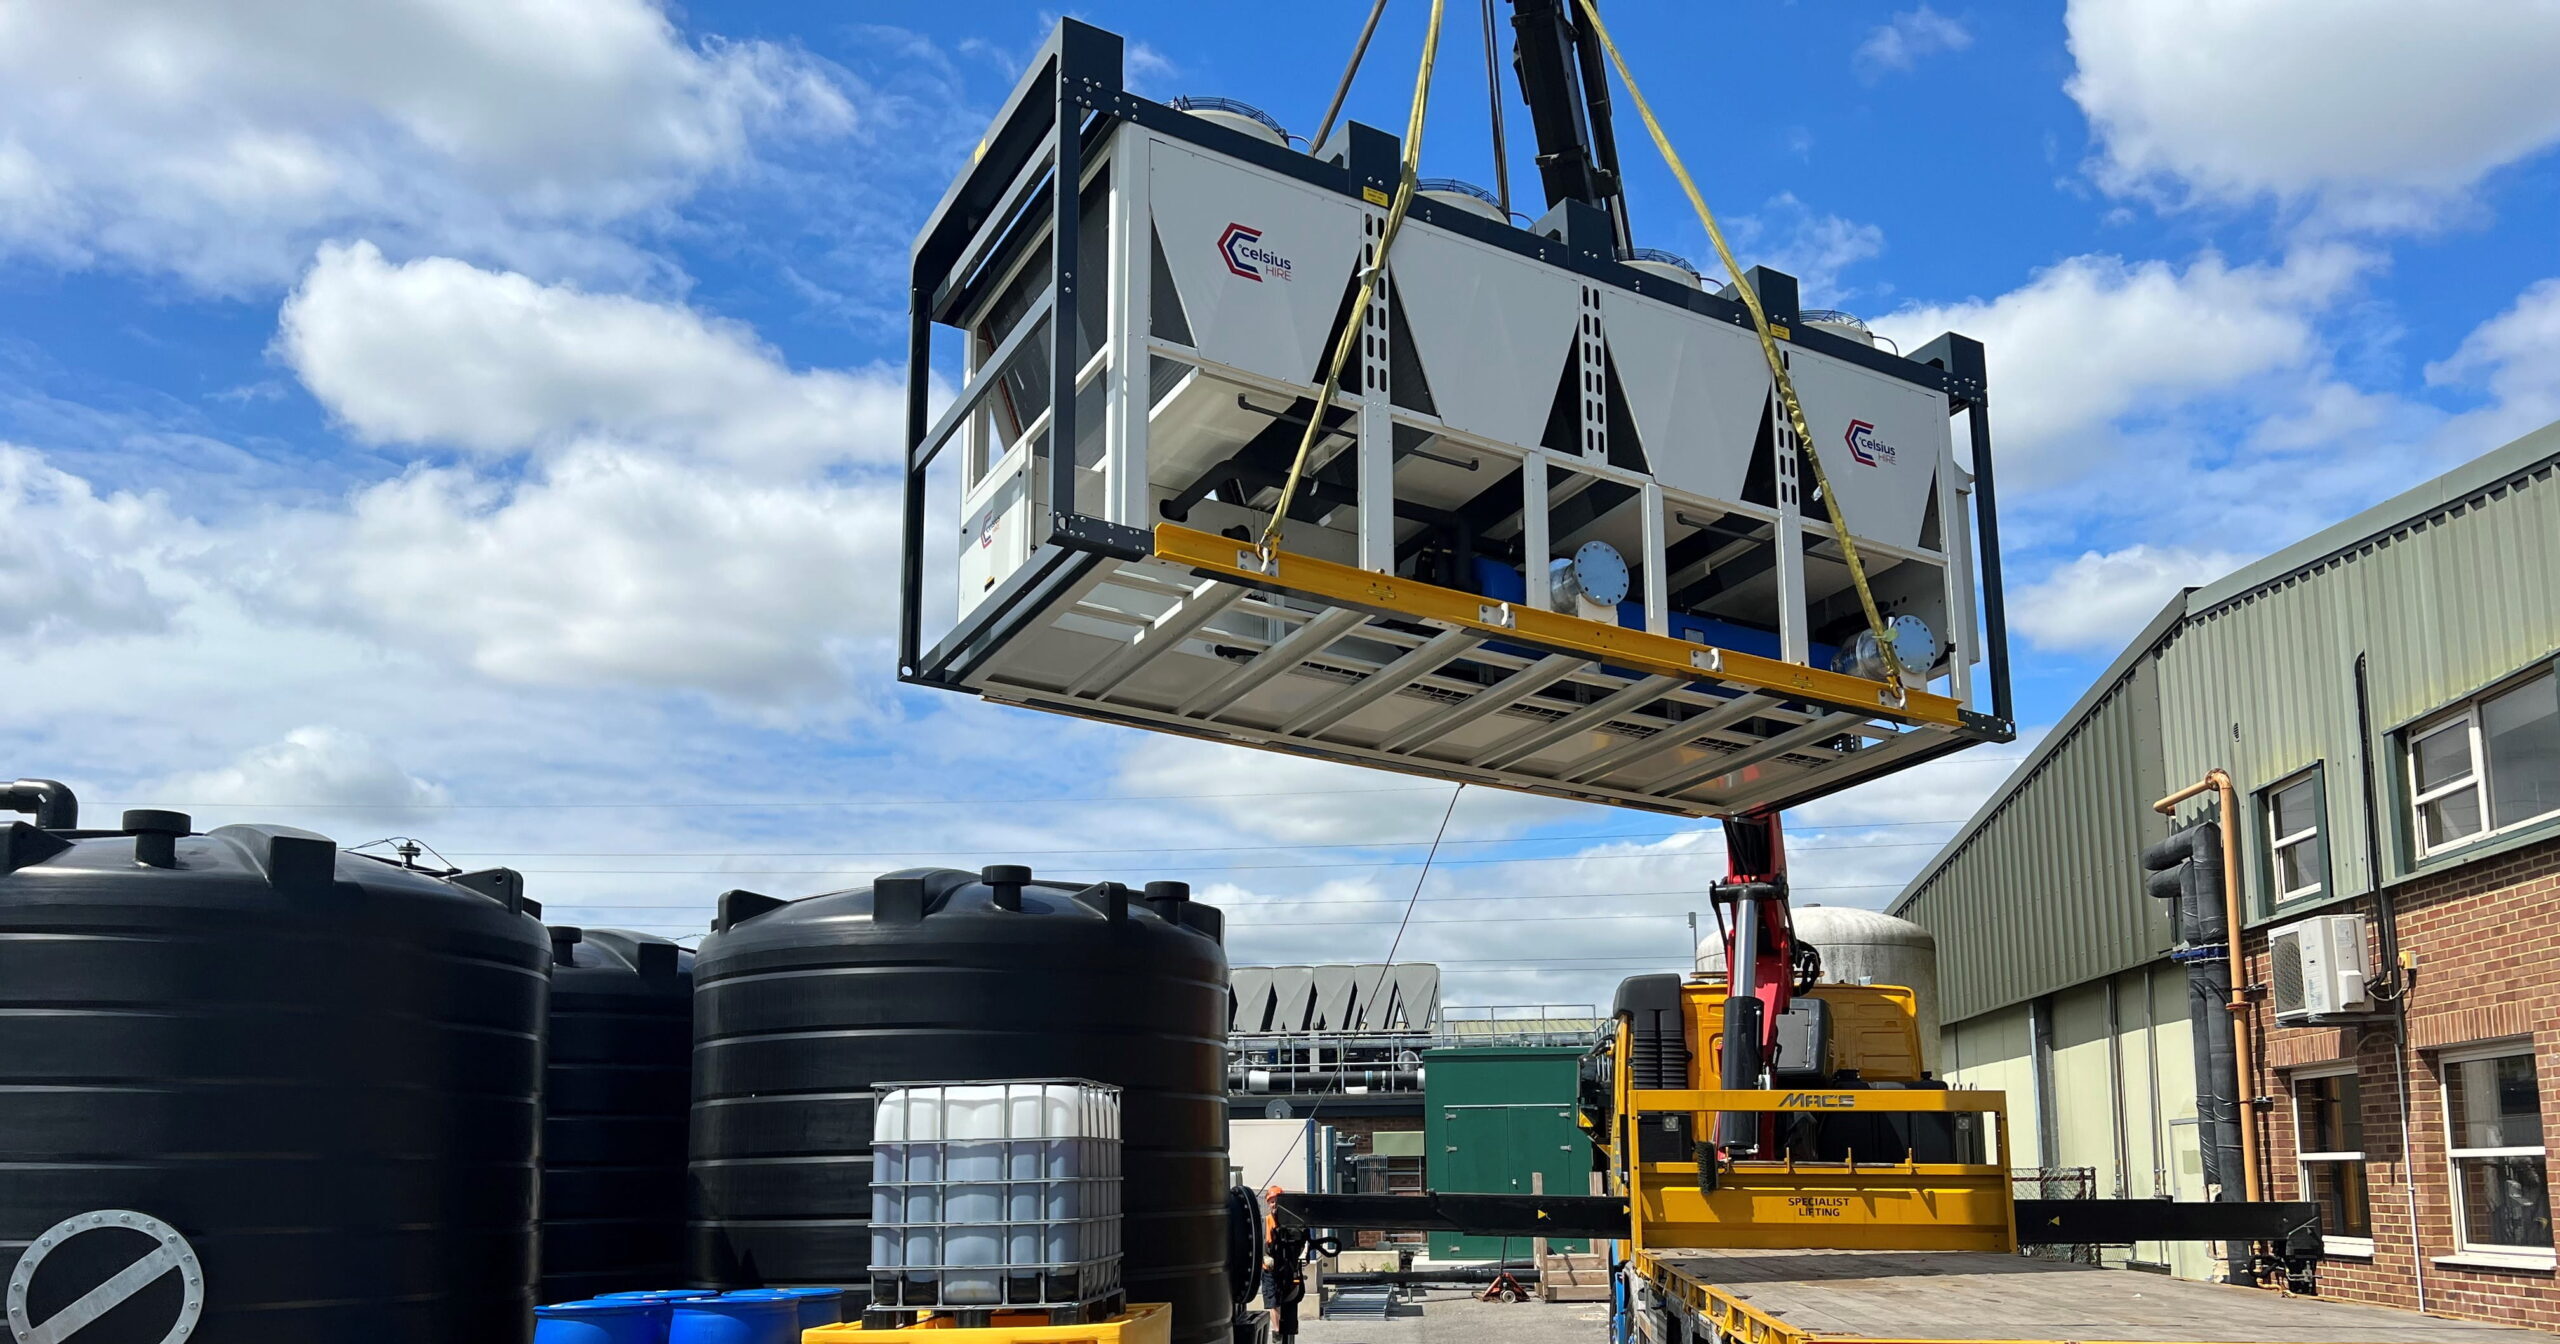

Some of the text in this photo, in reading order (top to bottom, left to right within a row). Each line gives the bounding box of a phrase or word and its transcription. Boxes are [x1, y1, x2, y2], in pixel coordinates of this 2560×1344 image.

[1265, 265, 1292, 282] HIRE
[1788, 1197, 1850, 1207] SPECIALIST
[1798, 1207, 1840, 1217] LIFTING
